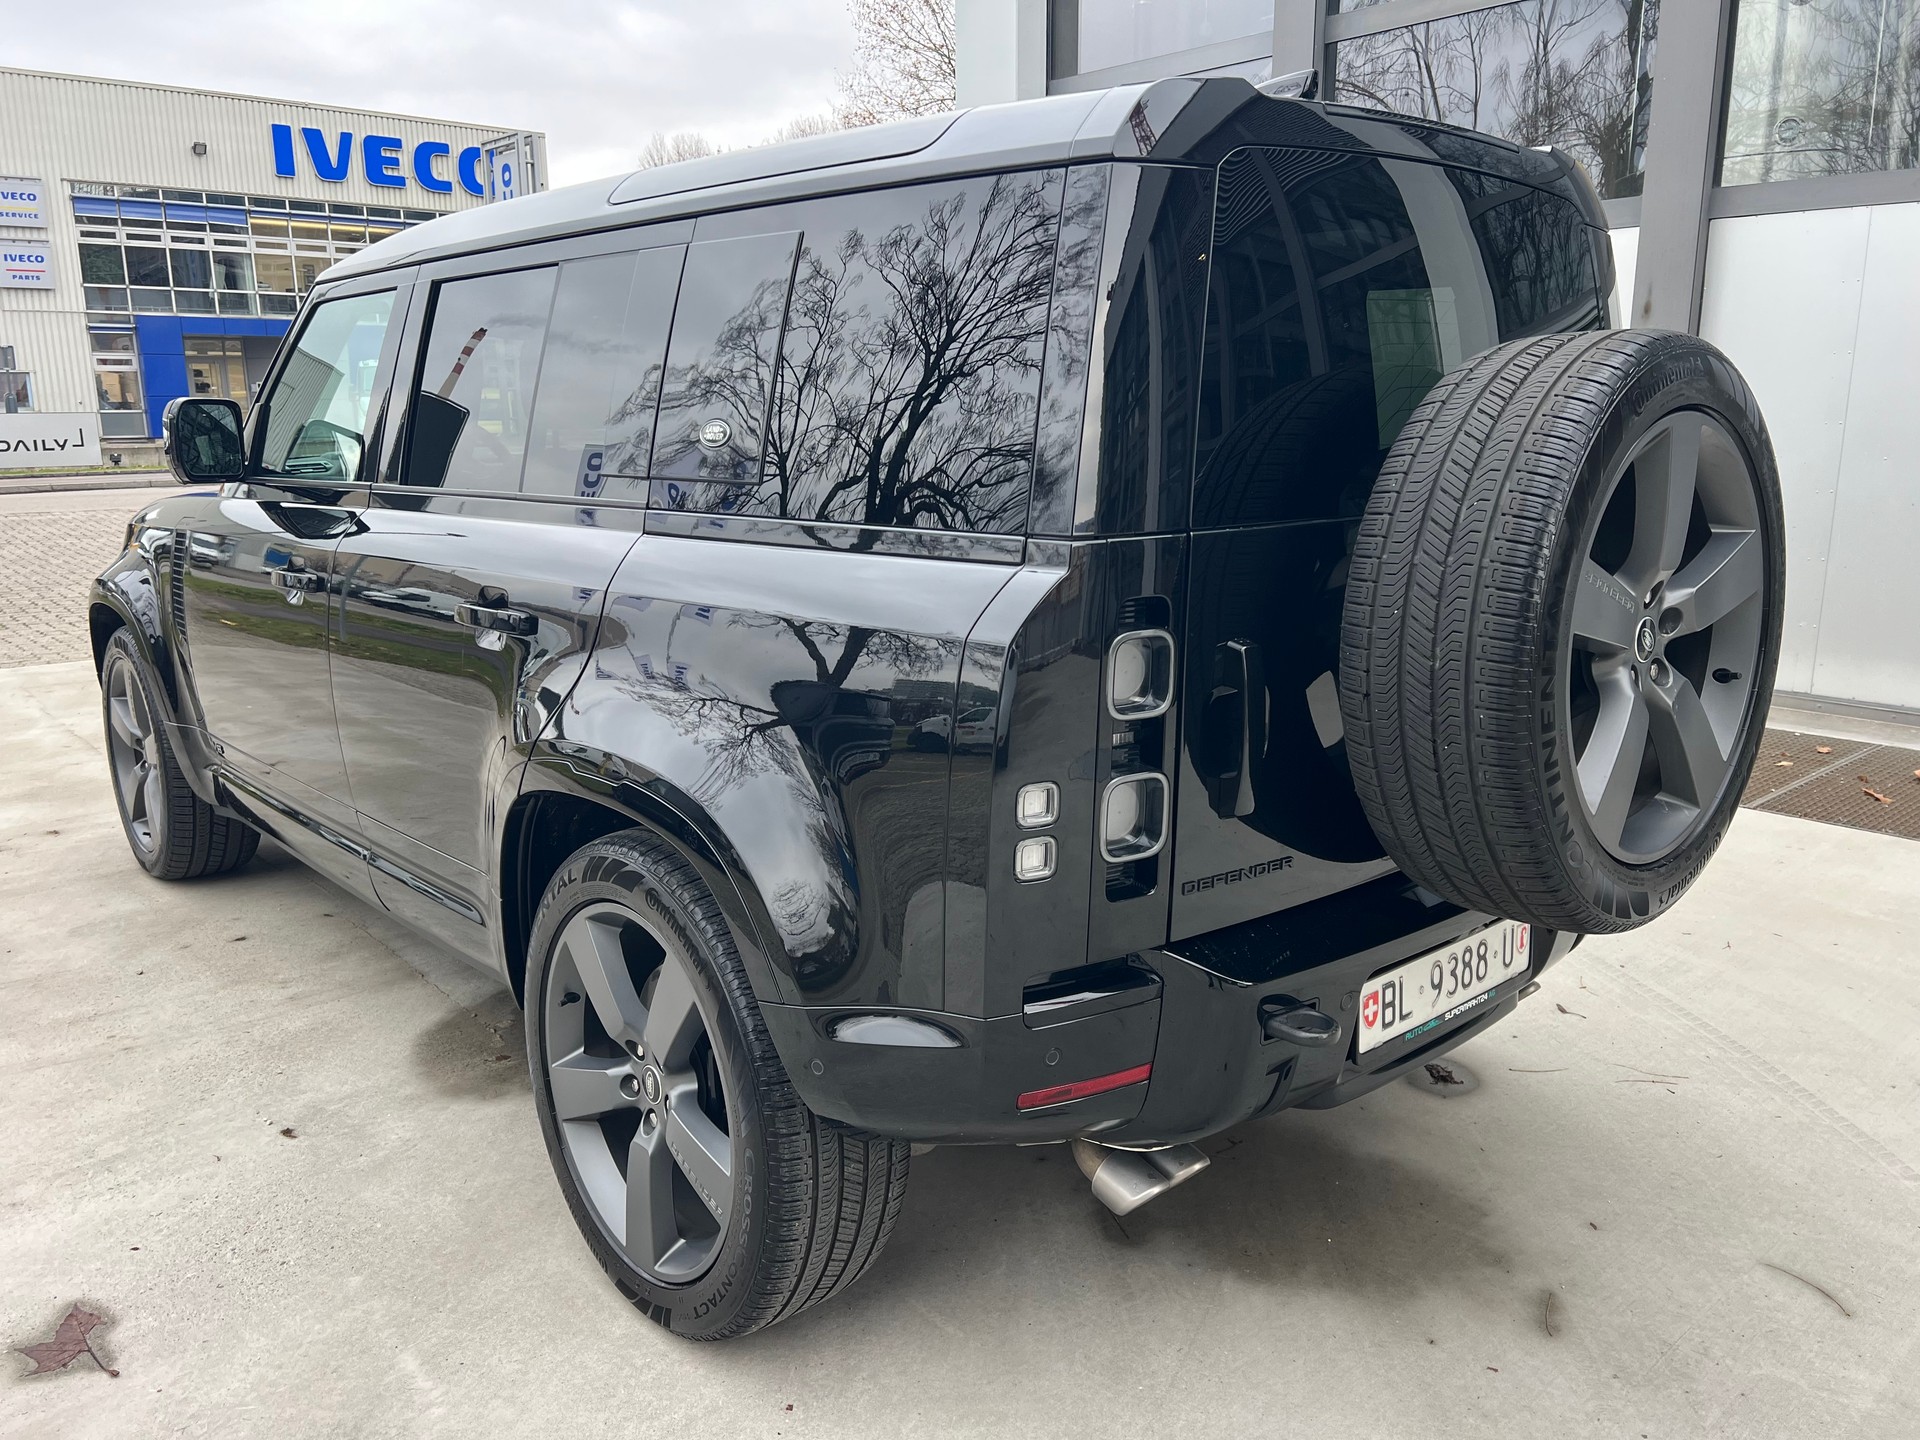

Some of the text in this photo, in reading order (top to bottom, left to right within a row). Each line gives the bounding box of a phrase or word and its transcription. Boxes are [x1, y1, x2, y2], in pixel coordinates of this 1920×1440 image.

[0, 191, 37, 202] VECO
[3, 253, 45, 264] IVECO
[1182, 856, 1294, 896] DEFENDER
[1382, 924, 1515, 1031] BL 9388 U
